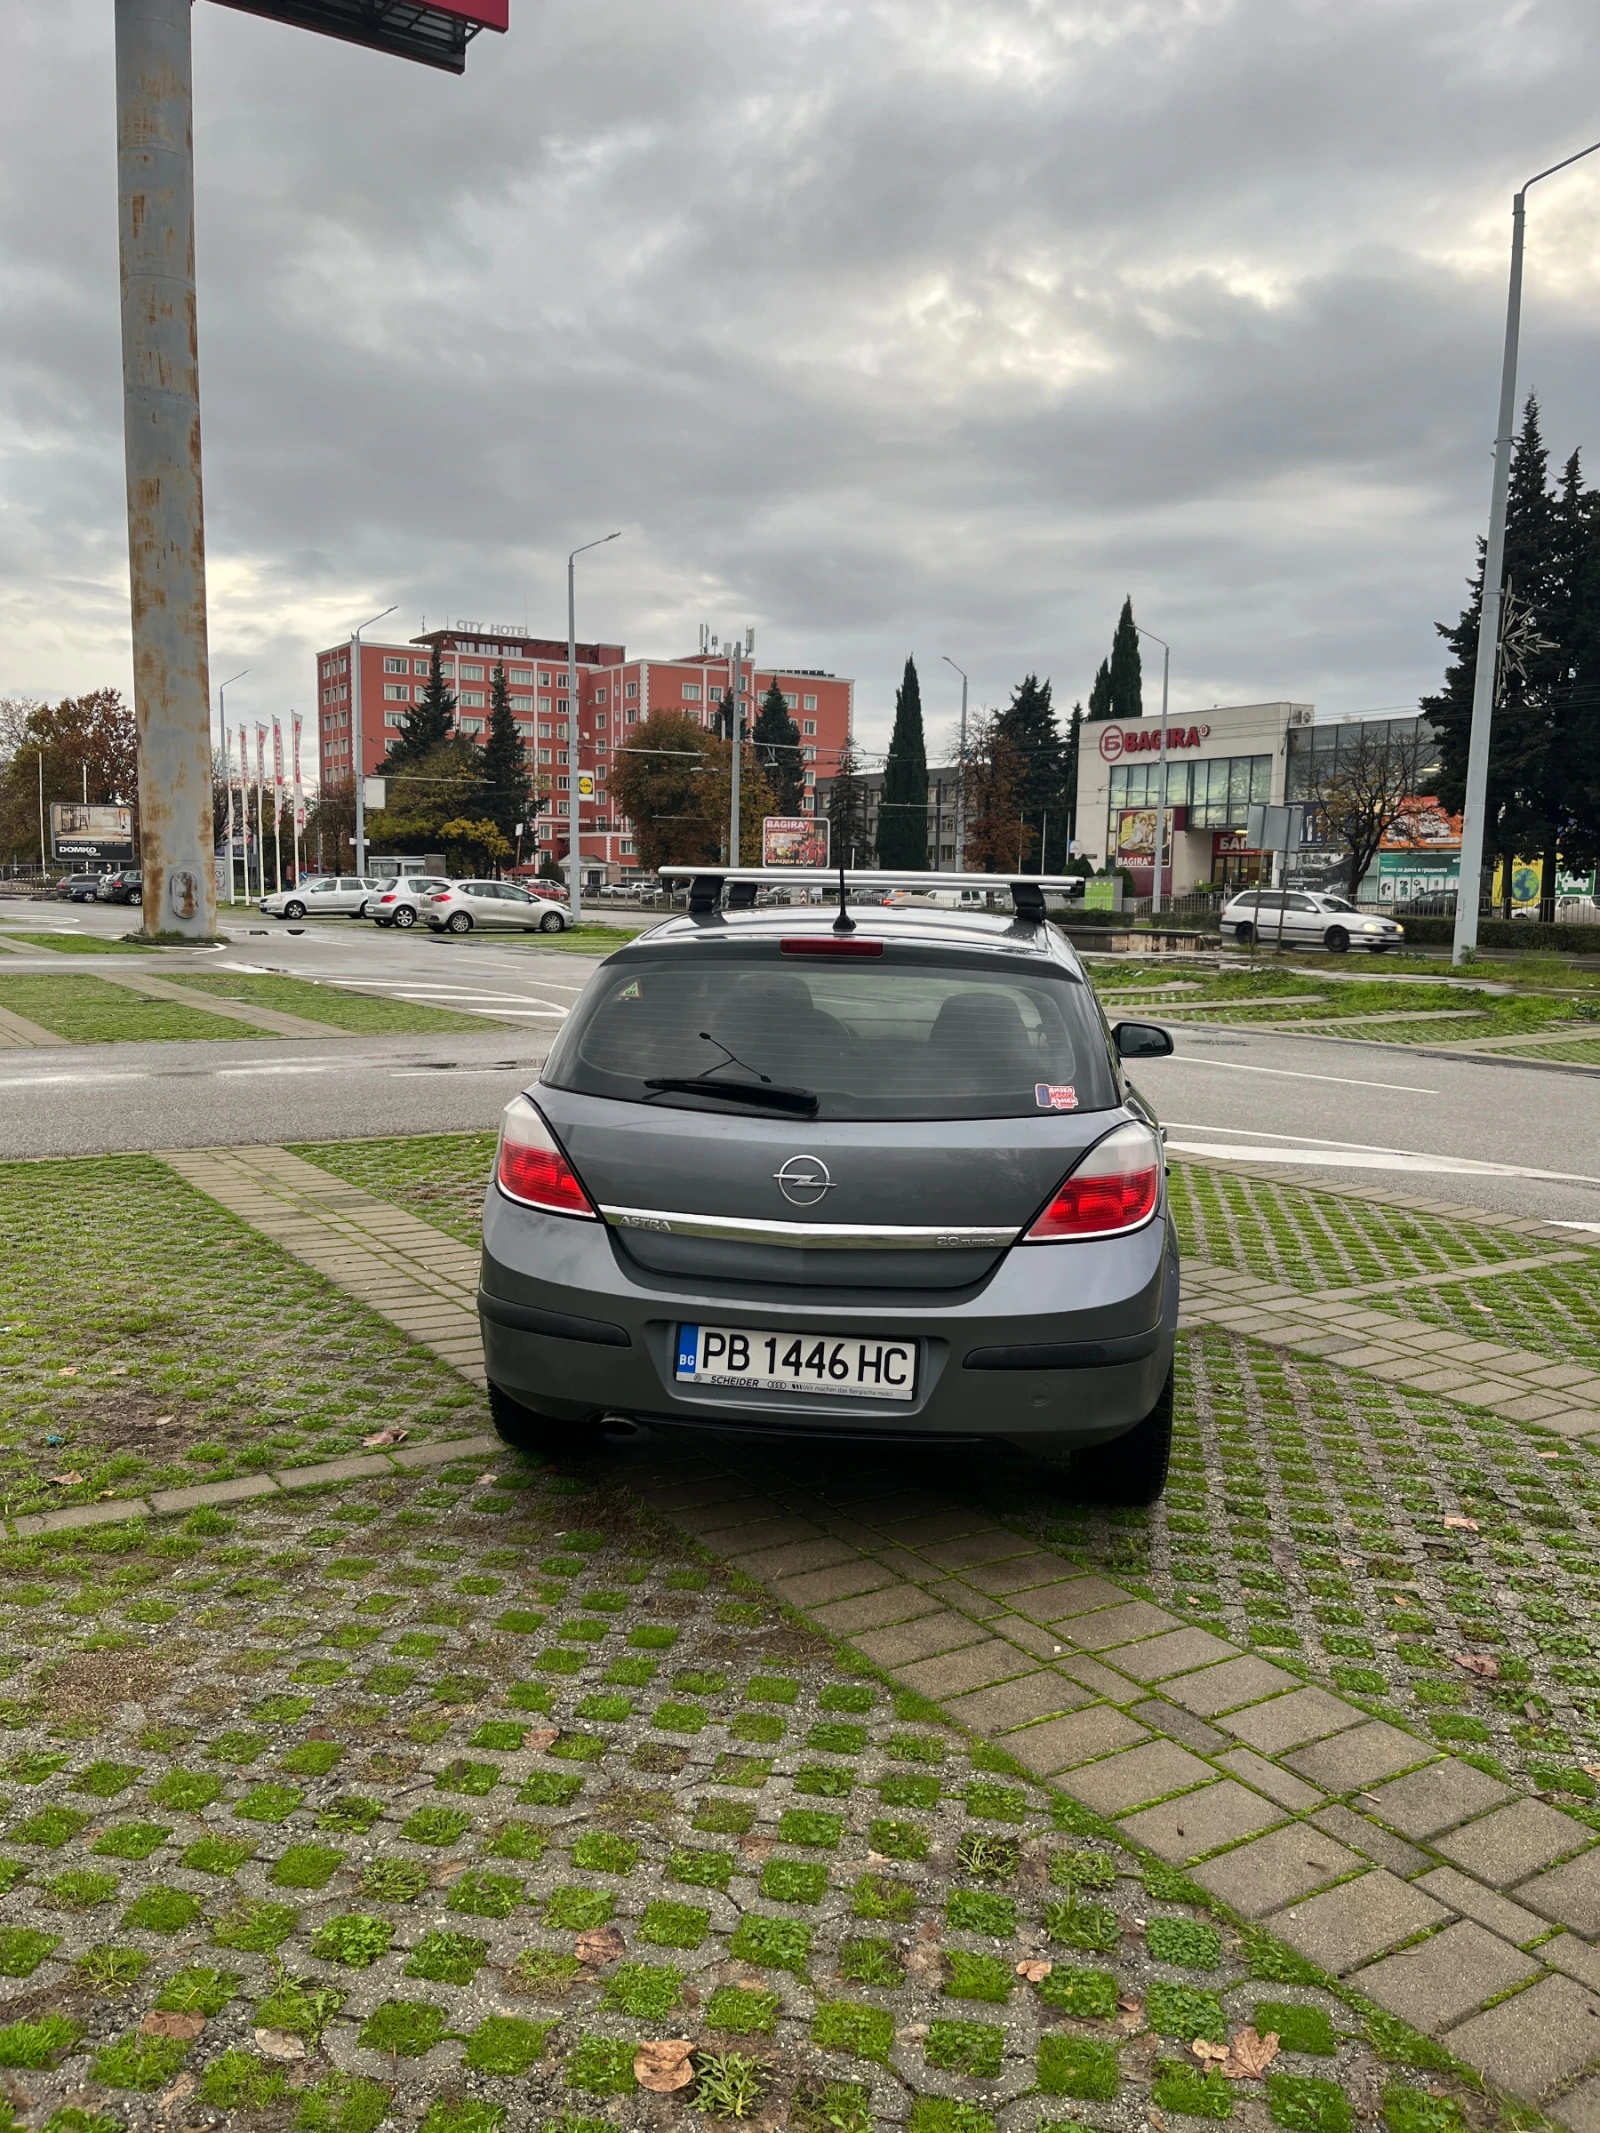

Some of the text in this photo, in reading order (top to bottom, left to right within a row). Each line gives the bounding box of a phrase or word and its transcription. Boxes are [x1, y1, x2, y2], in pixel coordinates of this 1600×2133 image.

[456, 620, 528, 637] CITY HOTEL
[59, 846, 97, 854] DOMKO
[620, 1215, 671, 1231] ASTRA
[960, 1238, 996, 1246] TURBO
[679, 1354, 695, 1367] BG
[702, 1332, 908, 1385] PB 1446 HC
[710, 1375, 760, 1388] SCHEIDER
